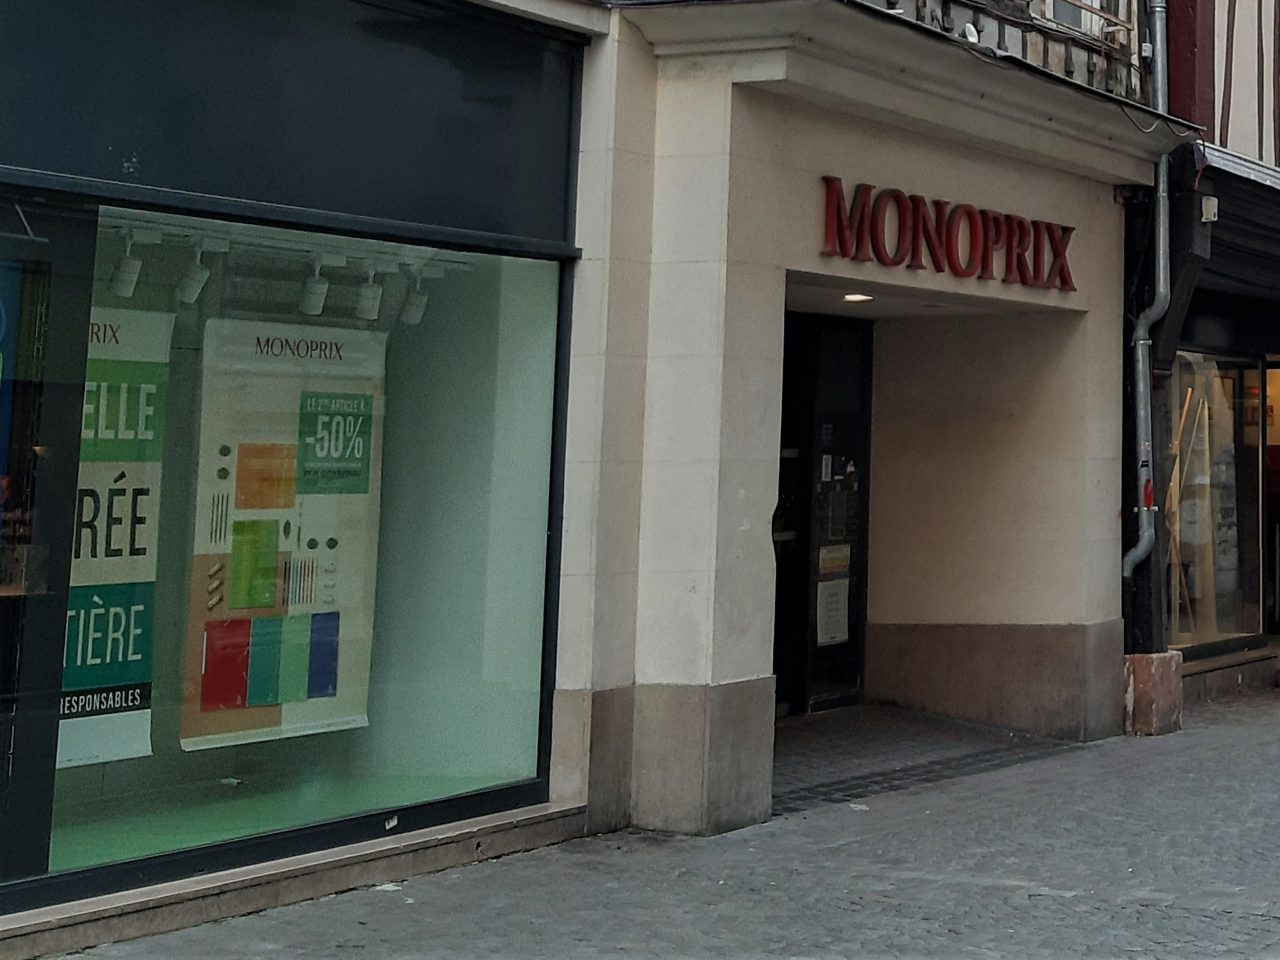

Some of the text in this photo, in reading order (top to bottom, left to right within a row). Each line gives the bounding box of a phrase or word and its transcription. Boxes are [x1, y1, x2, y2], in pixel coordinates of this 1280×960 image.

[819, 175, 1078, 292] MONOPRIX
[255, 336, 344, 360] MONOPRIX
[305, 415, 363, 458] -50%
[74, 470, 150, 559] RÉE
